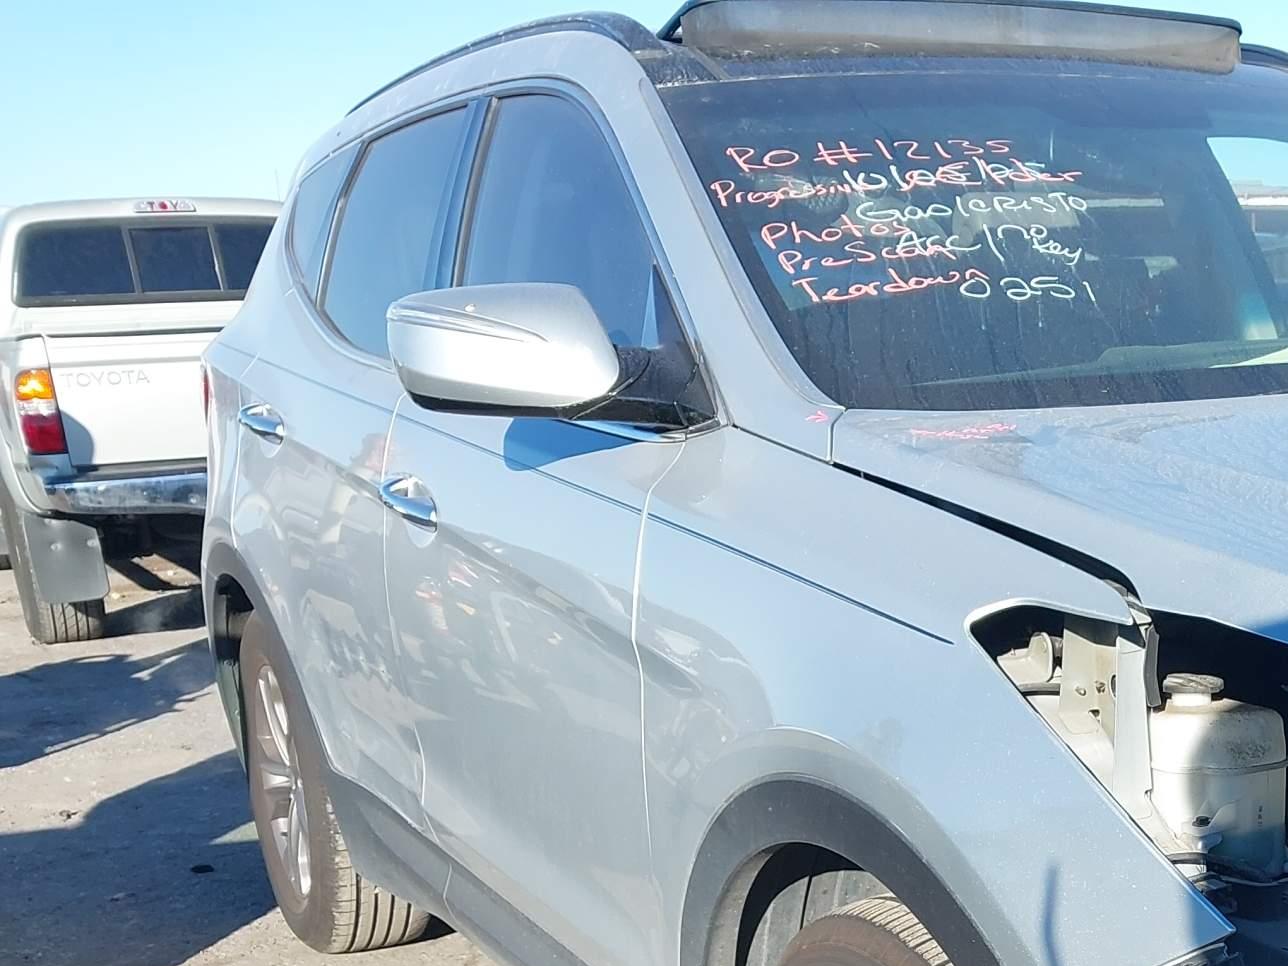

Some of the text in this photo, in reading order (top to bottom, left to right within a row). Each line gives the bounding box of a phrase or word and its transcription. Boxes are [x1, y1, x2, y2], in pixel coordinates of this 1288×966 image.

[725, 138, 1015, 173] RO #12135
[761, 215, 911, 249] Photos
[59, 368, 151, 388] TOYOTA
